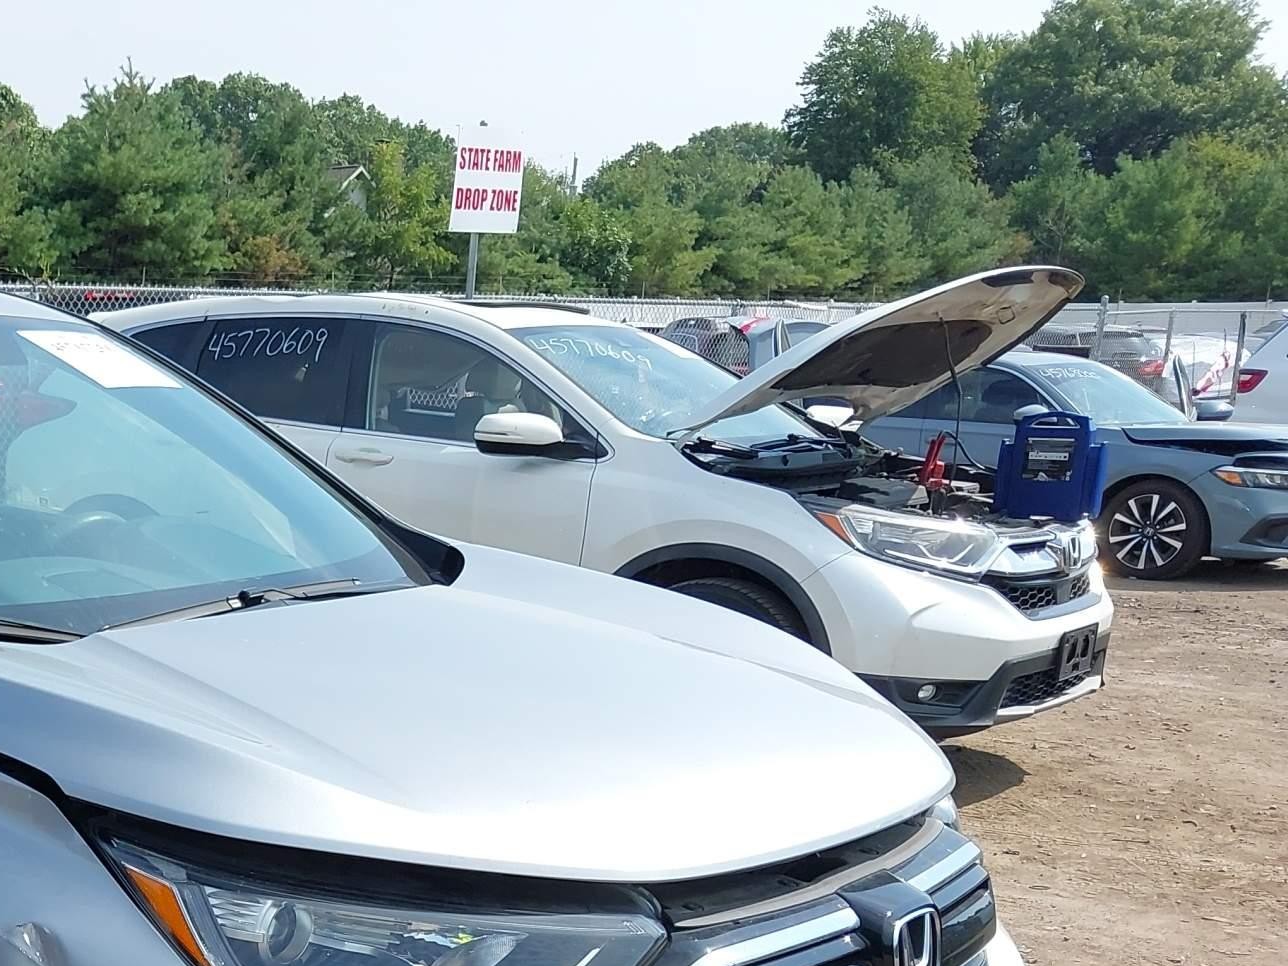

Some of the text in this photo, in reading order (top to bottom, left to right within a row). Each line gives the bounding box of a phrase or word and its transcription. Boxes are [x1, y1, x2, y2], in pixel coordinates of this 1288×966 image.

[459, 147, 522, 173] STATE FARM
[455, 187, 518, 212] DROP ZONE
[208, 327, 328, 362] 45770609
[529, 338, 652, 370] 45770609
